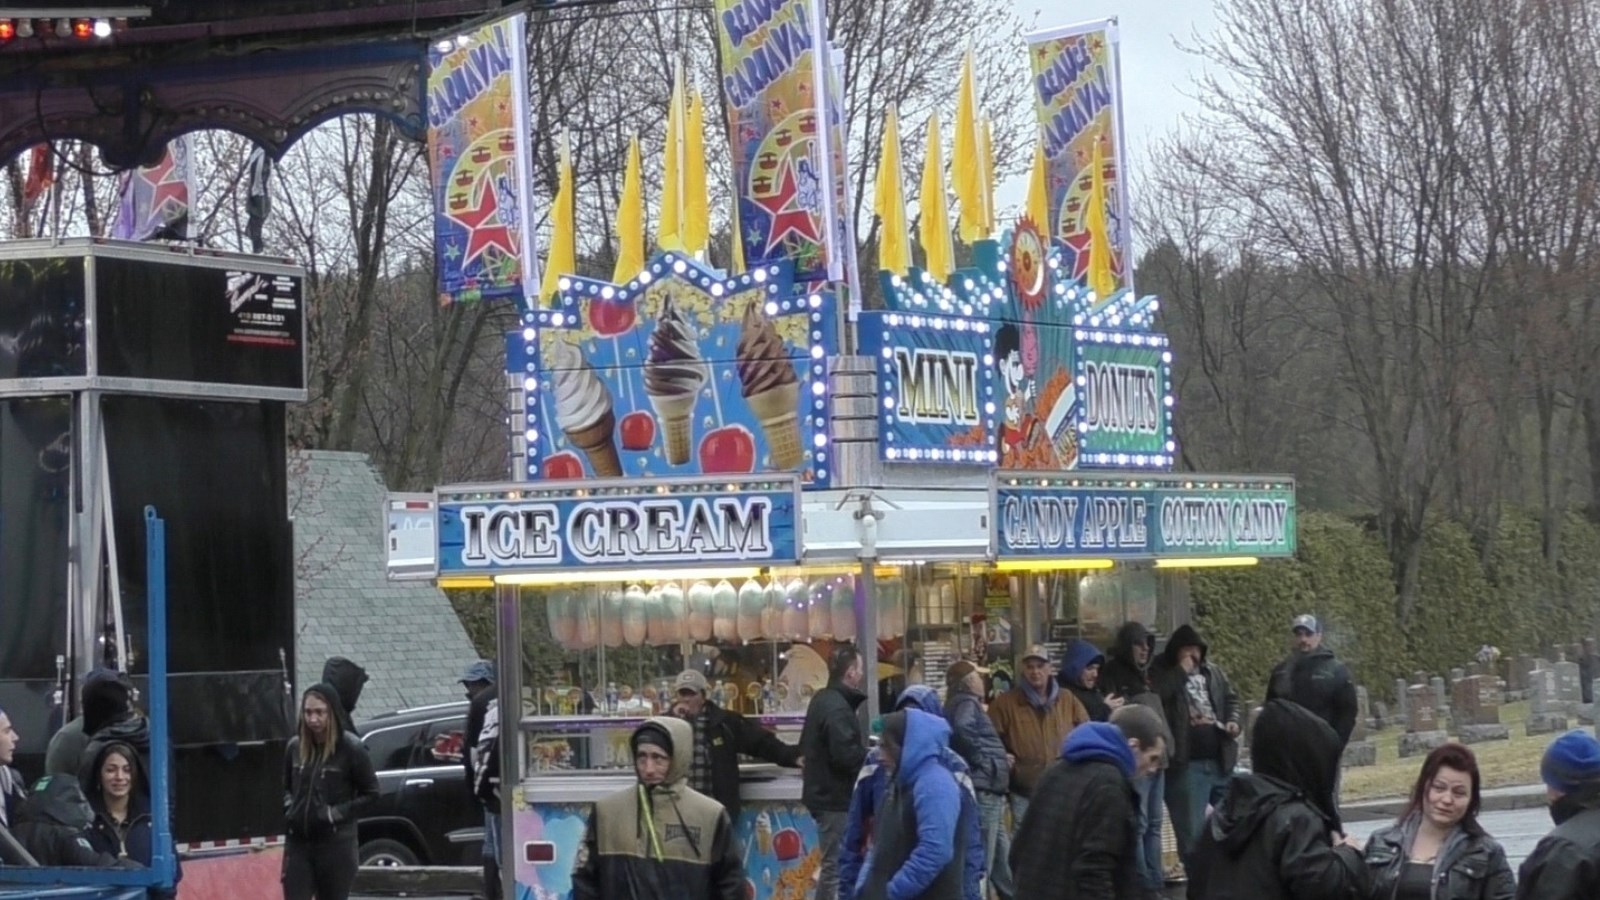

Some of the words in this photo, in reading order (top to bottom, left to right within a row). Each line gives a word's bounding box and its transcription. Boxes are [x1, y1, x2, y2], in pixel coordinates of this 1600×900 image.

[722, 0, 788, 47] BEAU
[724, 3, 811, 108] CARNAVAL
[1037, 38, 1092, 106] BEAUCE
[896, 350, 978, 424] MINI
[1086, 362, 1158, 433] DONUTS
[463, 507, 560, 563] ICE
[569, 499, 770, 559] CREAM
[1004, 496, 1077, 547] CANDY
[1081, 496, 1147, 547] APPLE
[1161, 497, 1229, 546] COTTON
[1232, 498, 1287, 546] CANDY
